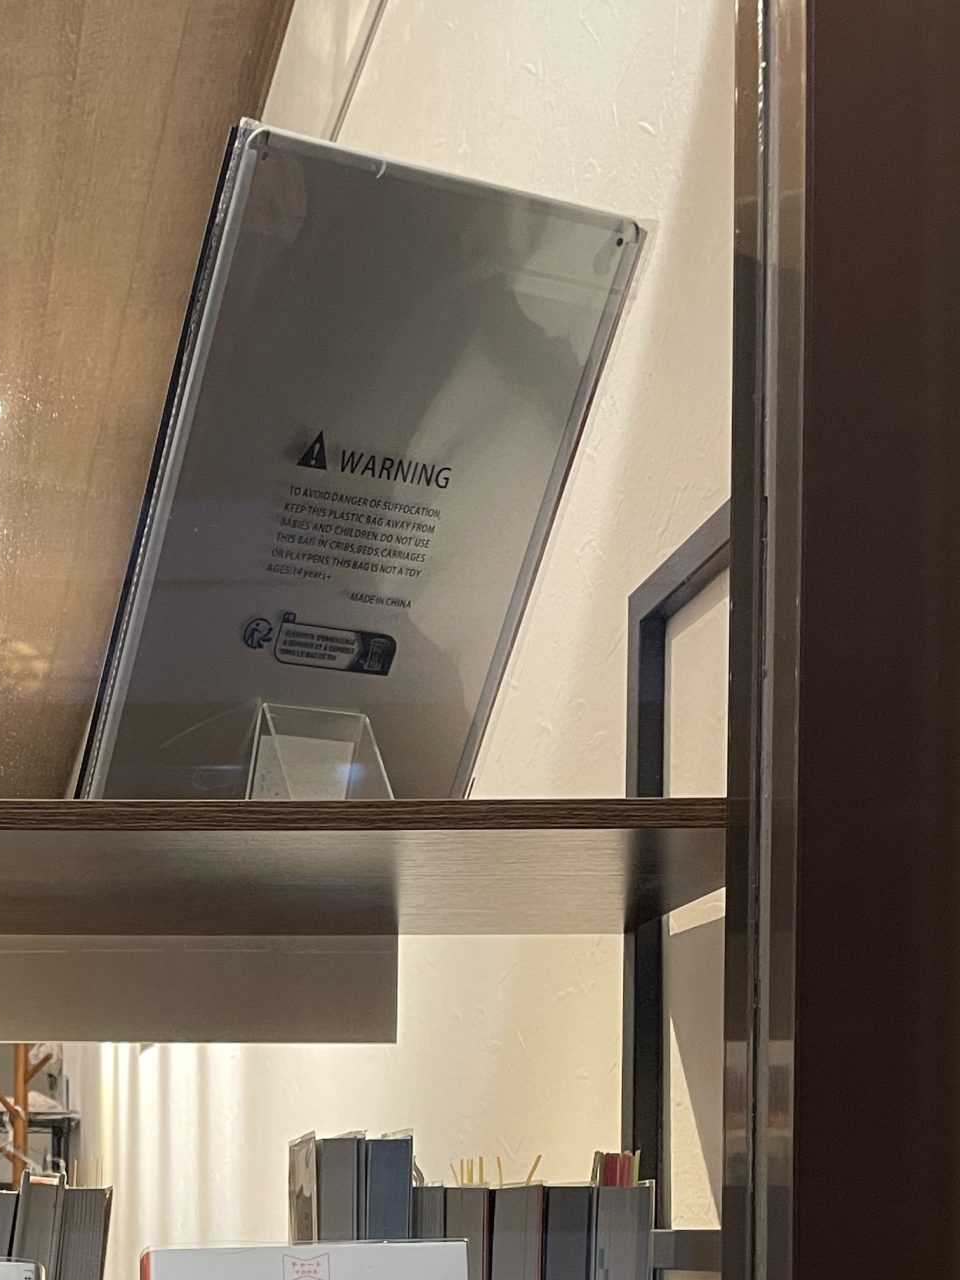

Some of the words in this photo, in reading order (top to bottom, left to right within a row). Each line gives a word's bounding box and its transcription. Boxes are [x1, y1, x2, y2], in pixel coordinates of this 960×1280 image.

[339, 449, 452, 489] WARNING
[288, 486, 301, 496] TO
[302, 488, 330, 500] AVOID
[331, 493, 368, 506] DANGER
[370, 499, 381, 508] OF
[284, 503, 305, 513] KEEP
[307, 506, 326, 517] THIS
[328, 510, 364, 522] PLASTIC
[365, 515, 384, 525] BAG
[385, 518, 411, 529] AWAY
[412, 522, 435, 533] FROM
[276, 532, 295, 543] THIS
[297, 535, 315, 546] BAG
[317, 538, 327, 548] IN
[312, 522, 332, 533] AND
[395, 535, 412, 545] NOT
[415, 538, 430, 548] USE
[332, 557, 351, 567] THIS
[352, 560, 371, 570] BAG
[372, 563, 379, 571] IS
[380, 564, 396, 574] NOT
[350, 592, 376, 603] MADE
[386, 597, 412, 609] CHINA
